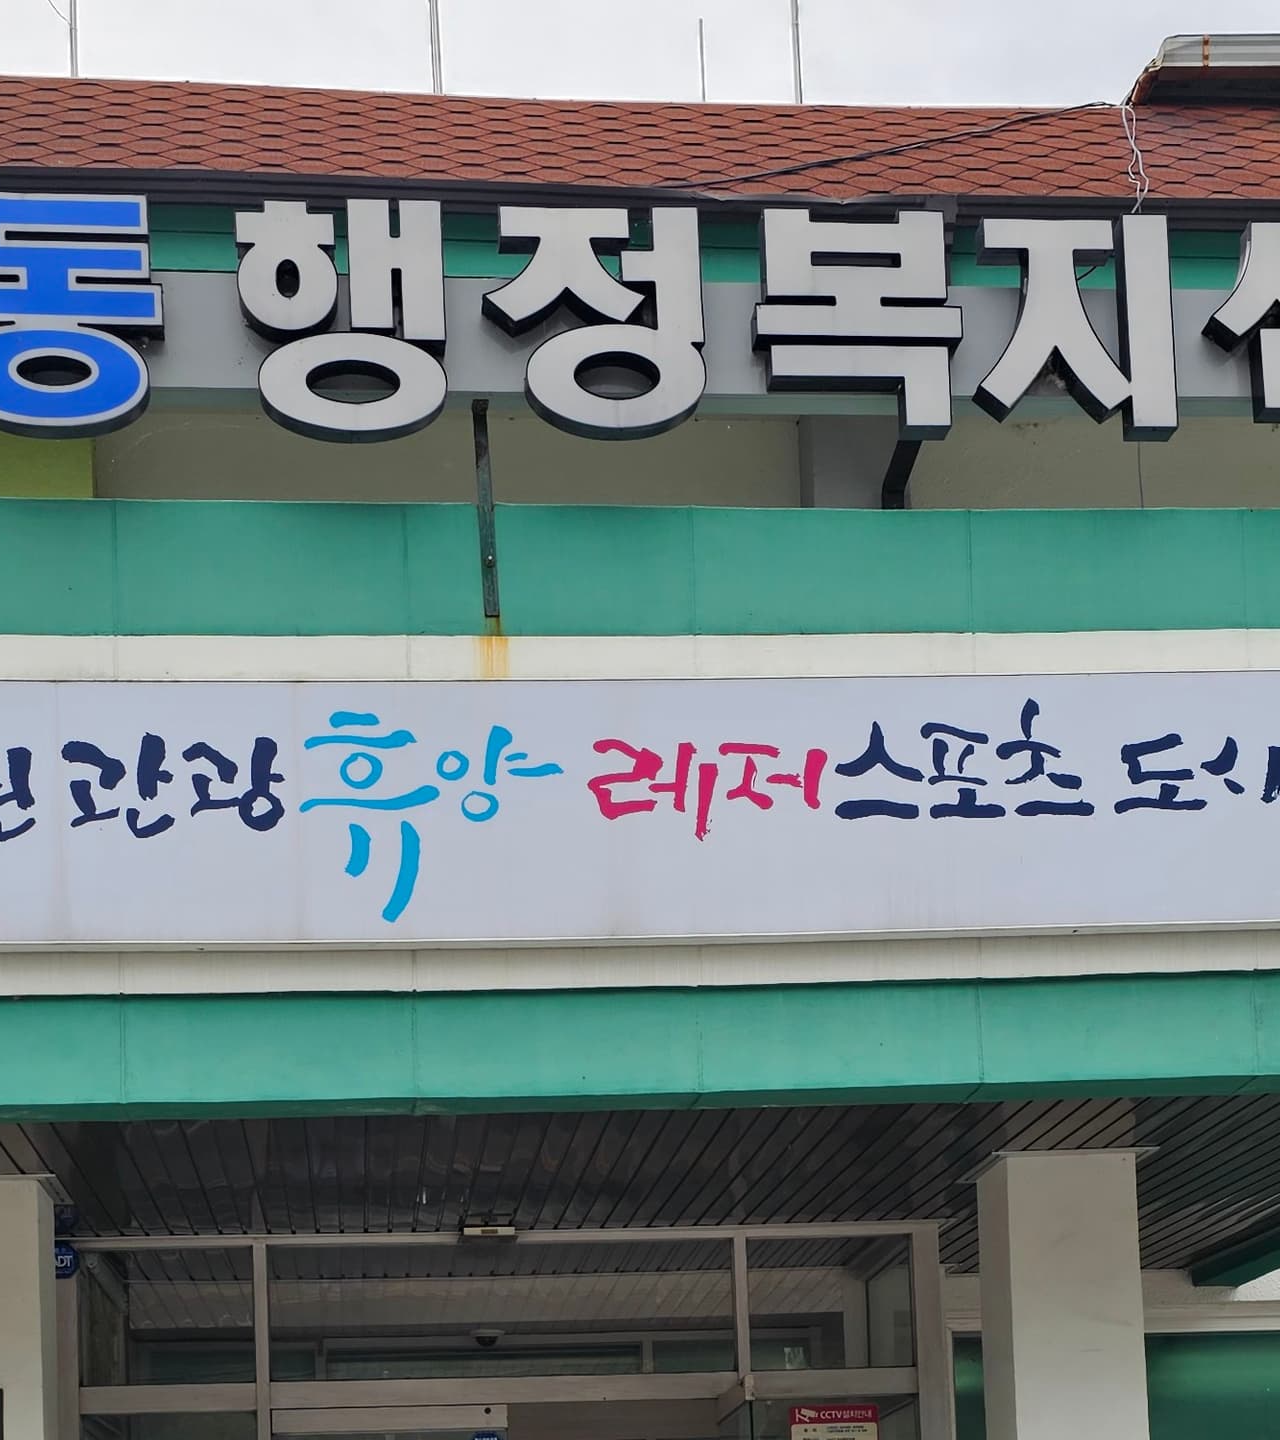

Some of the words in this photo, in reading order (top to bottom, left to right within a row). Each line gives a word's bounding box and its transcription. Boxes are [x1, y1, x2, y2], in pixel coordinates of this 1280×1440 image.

[62, 732, 285, 838] 관광
[300, 710, 563, 924] 휴양
[588, 738, 828, 840] 레저
[834, 697, 1094, 821] 스포츠
